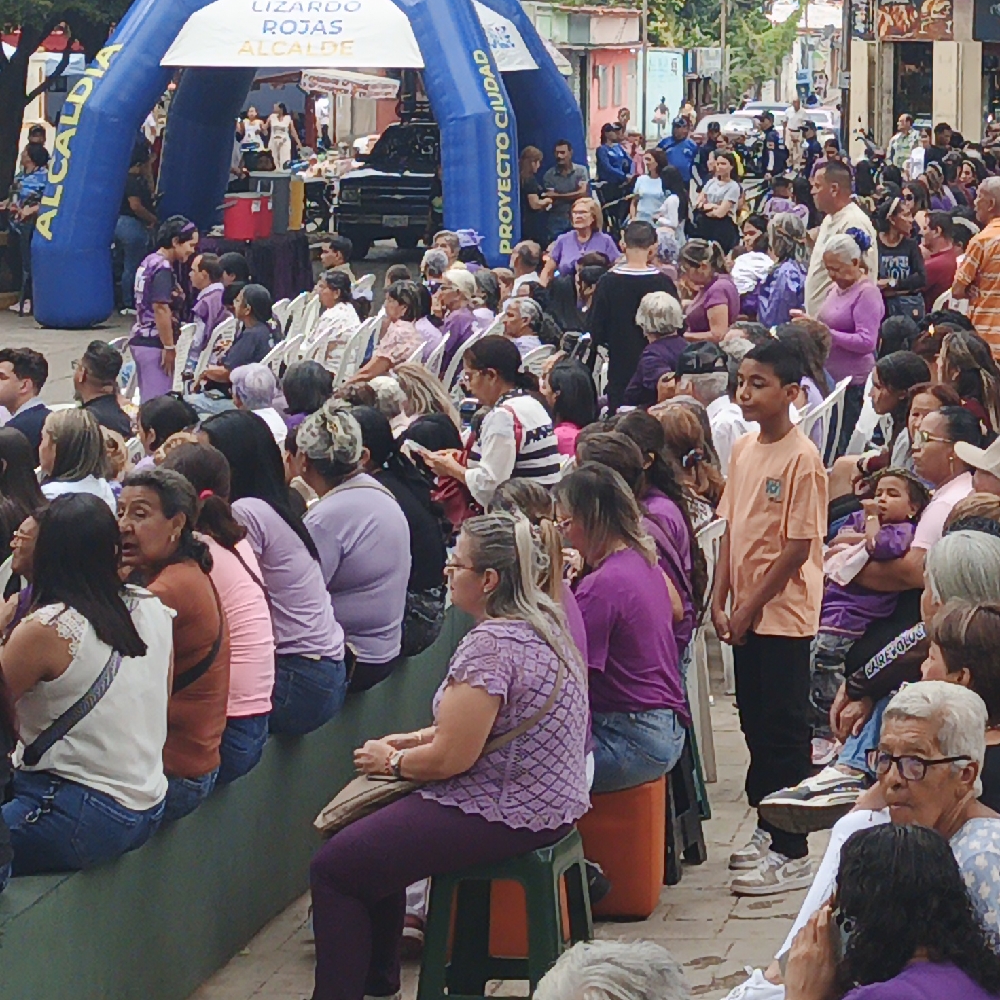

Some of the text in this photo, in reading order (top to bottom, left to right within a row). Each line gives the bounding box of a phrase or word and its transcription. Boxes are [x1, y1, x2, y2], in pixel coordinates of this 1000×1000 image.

[251, 0, 361, 13] LIZARDO
[262, 19, 343, 35] ROJAS
[237, 39, 354, 56] ALCALDE
[473, 49, 509, 129] CIUDAD
[495, 131, 514, 255] PROYECTO
